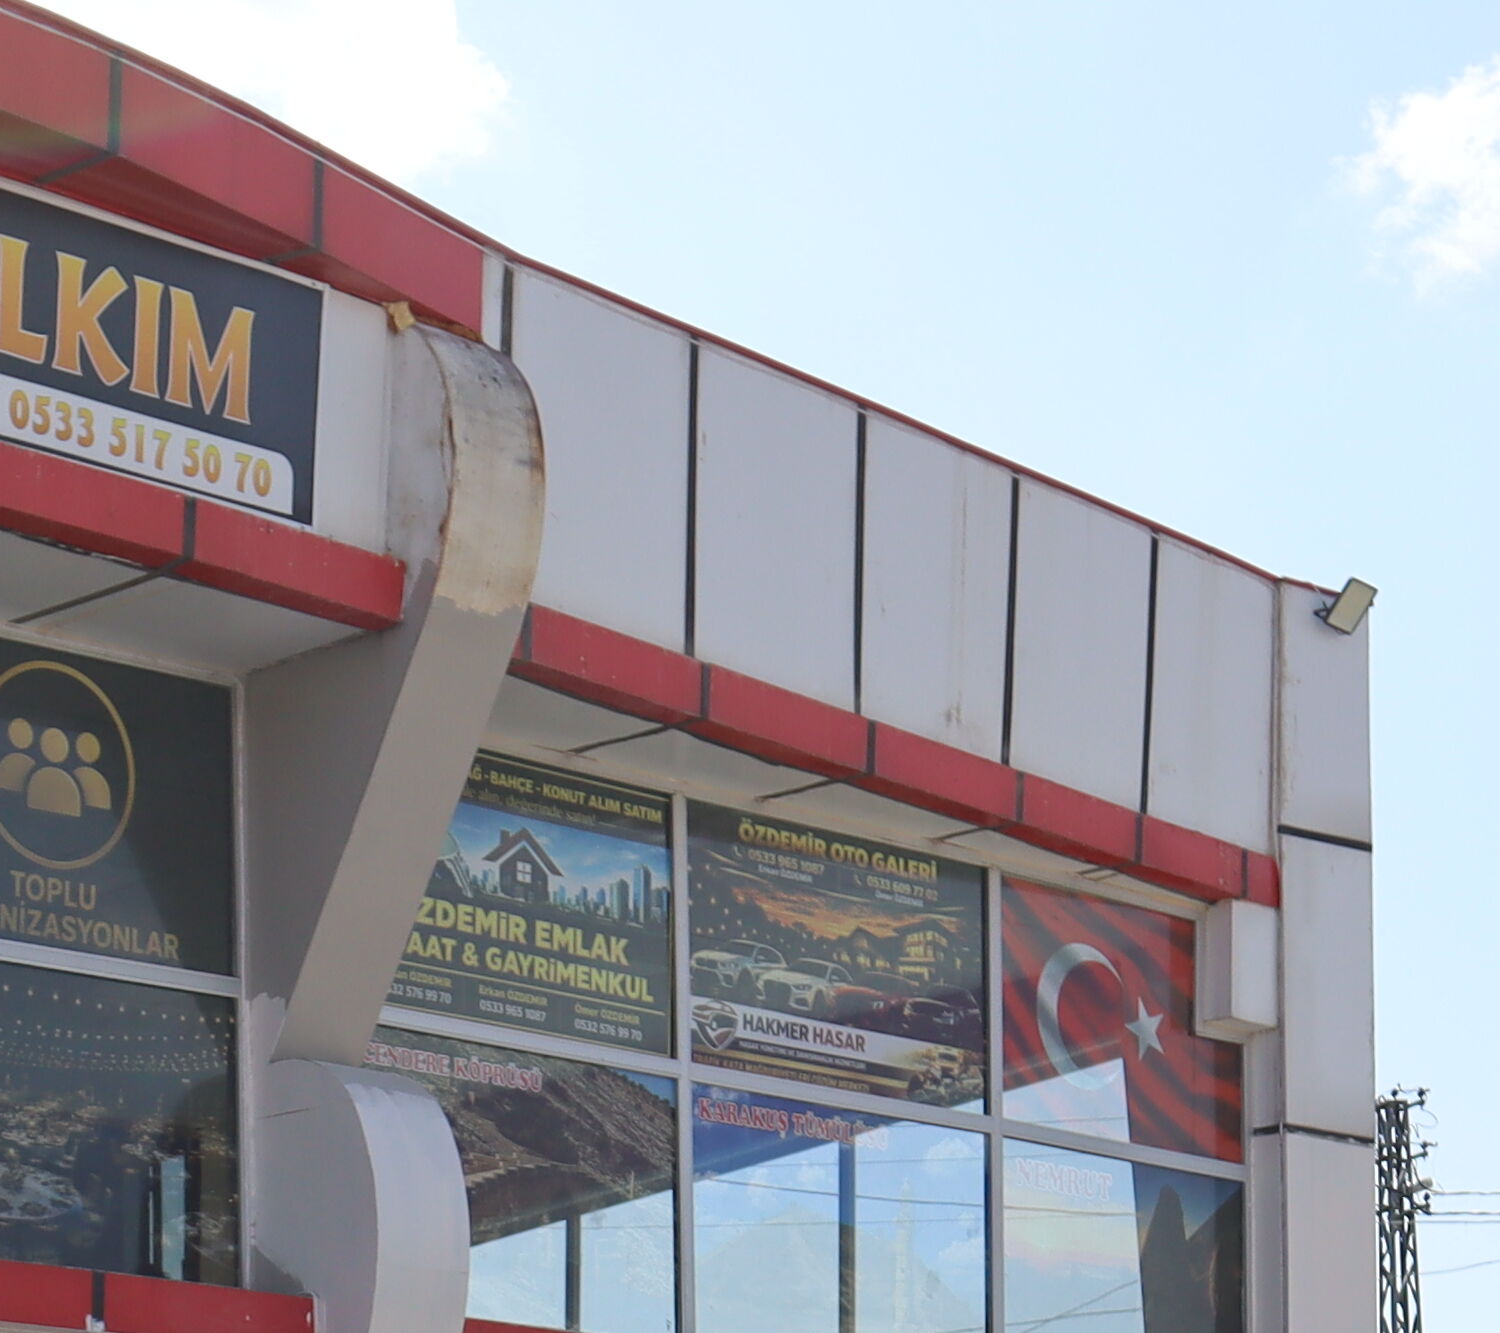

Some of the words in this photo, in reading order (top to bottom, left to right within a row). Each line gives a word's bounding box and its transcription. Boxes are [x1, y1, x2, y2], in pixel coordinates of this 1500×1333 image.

[10, 389, 95, 448] 0533
[108, 416, 171, 471] 517
[182, 436, 222, 484] 50
[234, 452, 272, 497] 70
[738, 816, 827, 859] ÖZDEMİR
[830, 842, 869, 868] OTO
[872, 852, 938, 883] GALERİ
[10, 869, 97, 912] TOPLU
[462, 943, 479, 968] &
[534, 920, 630, 967] EMLAK
[743, 1012, 809, 1042] HAKMER
[812, 1026, 866, 1053] HASAR
[454, 1056, 543, 1093] KÖPRÜSÜ
[696, 1097, 789, 1139] KARAKUŞ
[1013, 1157, 1115, 1202] NEMRUT
